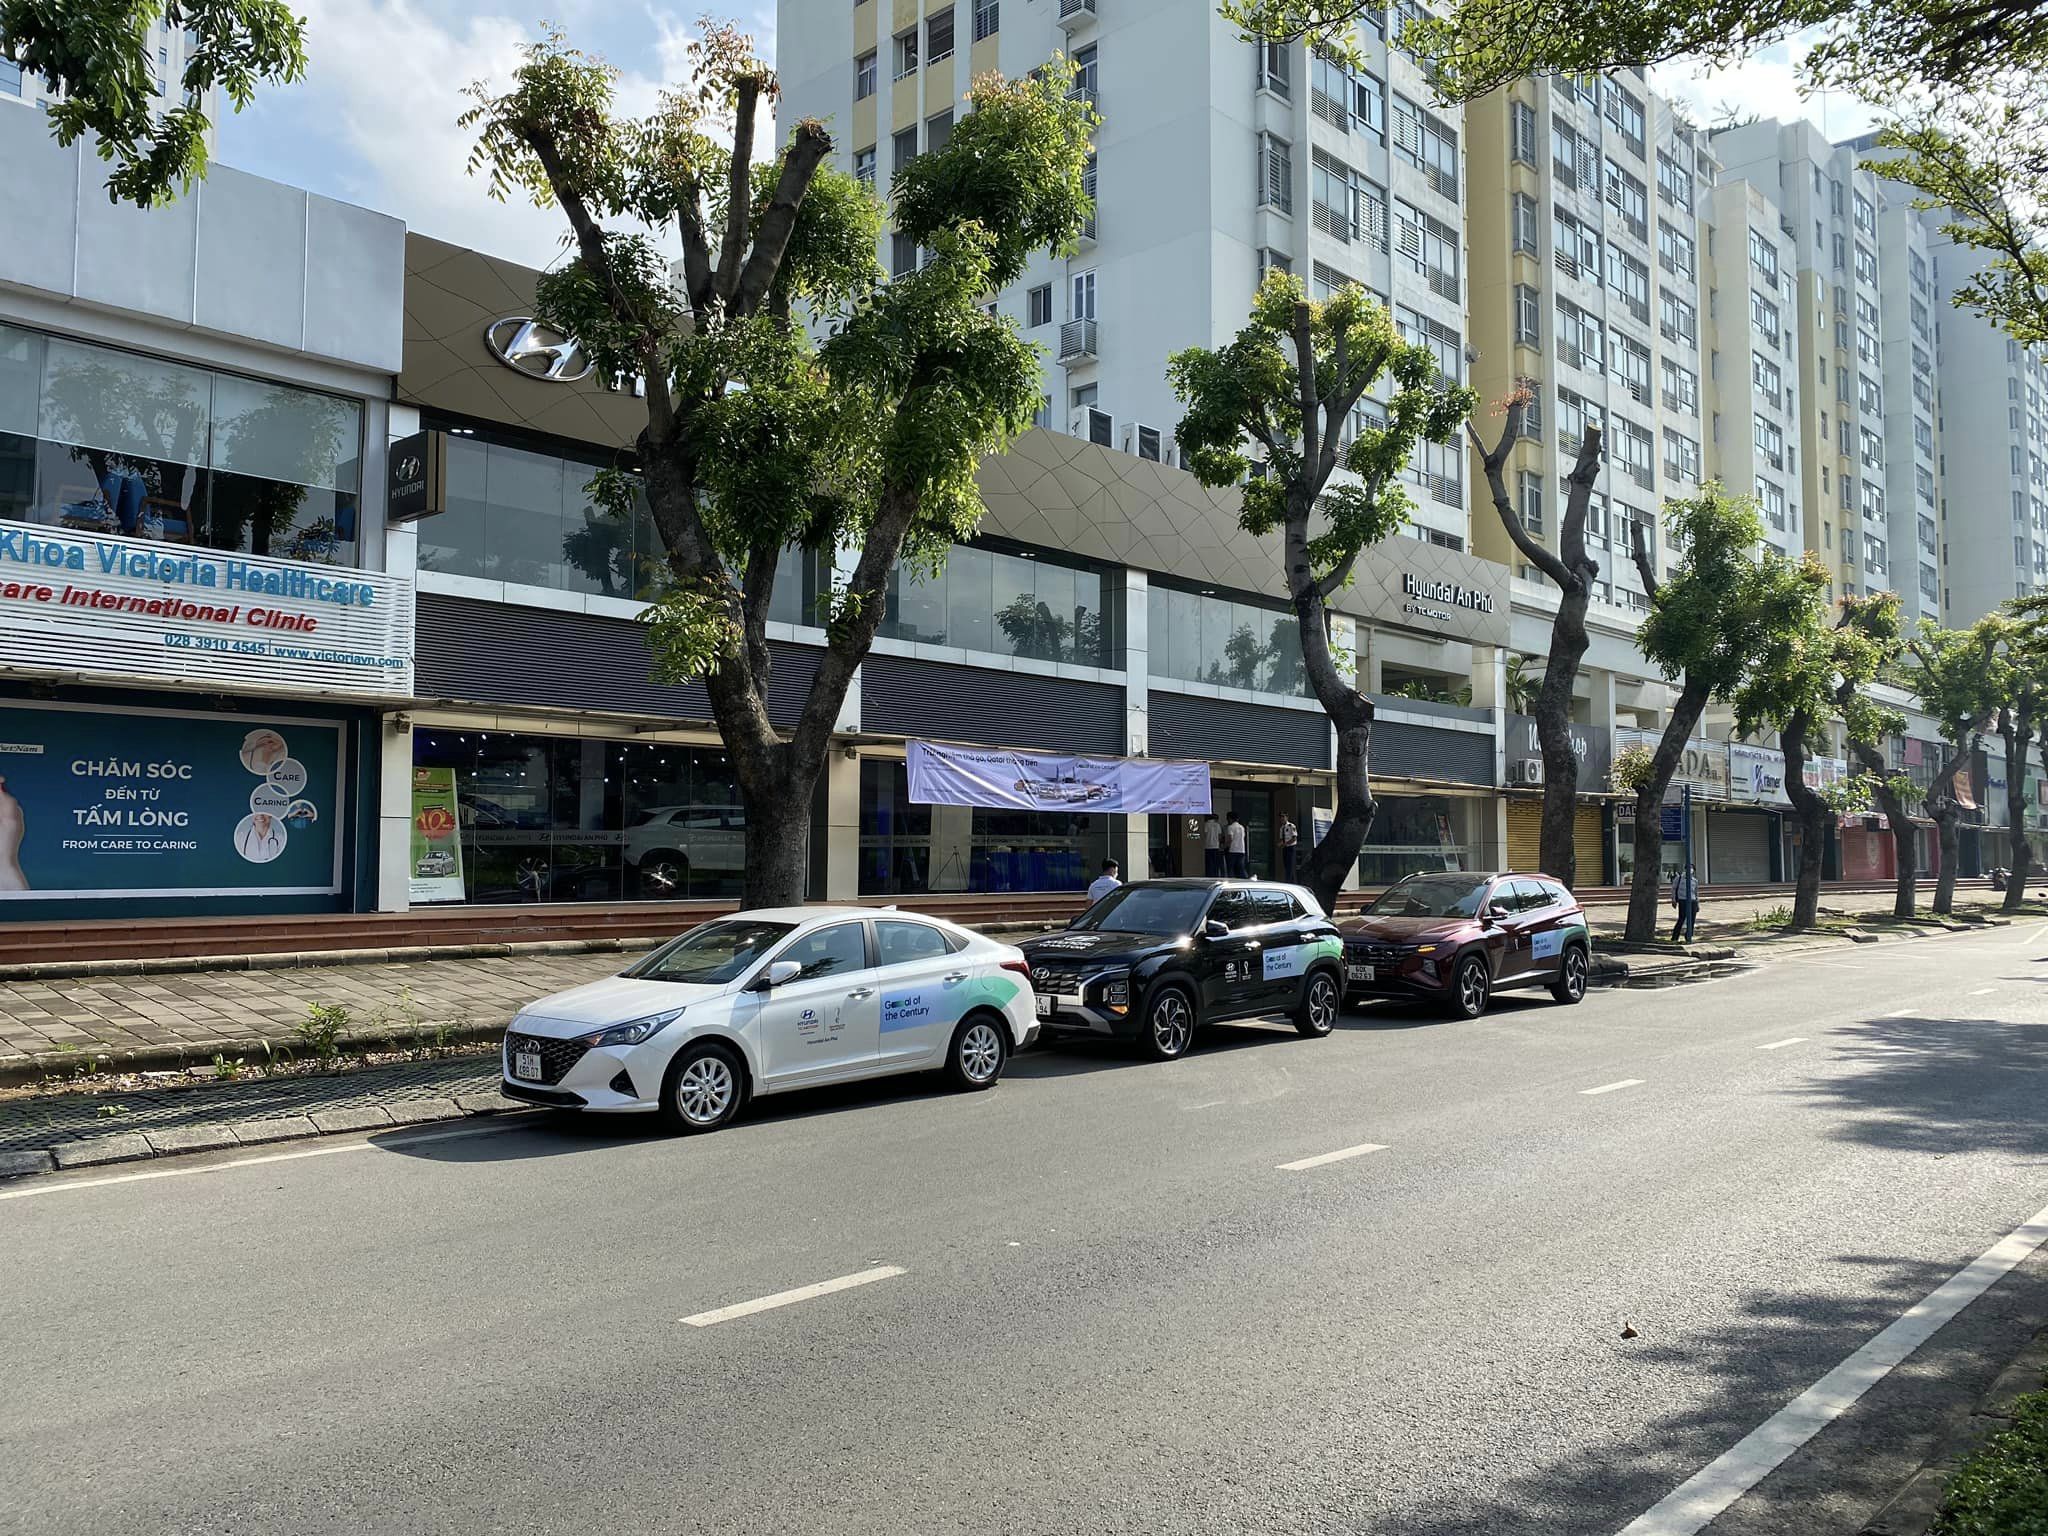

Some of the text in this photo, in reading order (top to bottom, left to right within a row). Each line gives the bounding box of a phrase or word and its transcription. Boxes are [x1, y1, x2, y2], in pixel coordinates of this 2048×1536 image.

[391, 480, 425, 499] HYUNDAI
[0, 528, 374, 607] Khoa Victoria Healthcare
[1404, 573, 1454, 603] Hyundai
[1457, 585, 1472, 609] An
[60, 585, 240, 624] International
[246, 607, 320, 632] Clinic
[164, 633, 404, 668] 028 3910 4545 www.victoriavn.com
[71, 757, 193, 779] CHĂM SÓC
[105, 785, 161, 800] ĐẾN TỪ
[73, 803, 189, 827] TẤM LÒNG
[62, 840, 197, 849] FROM CARE TO CARING
[885, 1006, 930, 1021] the Century
[521, 1053, 534, 1066] 51H
